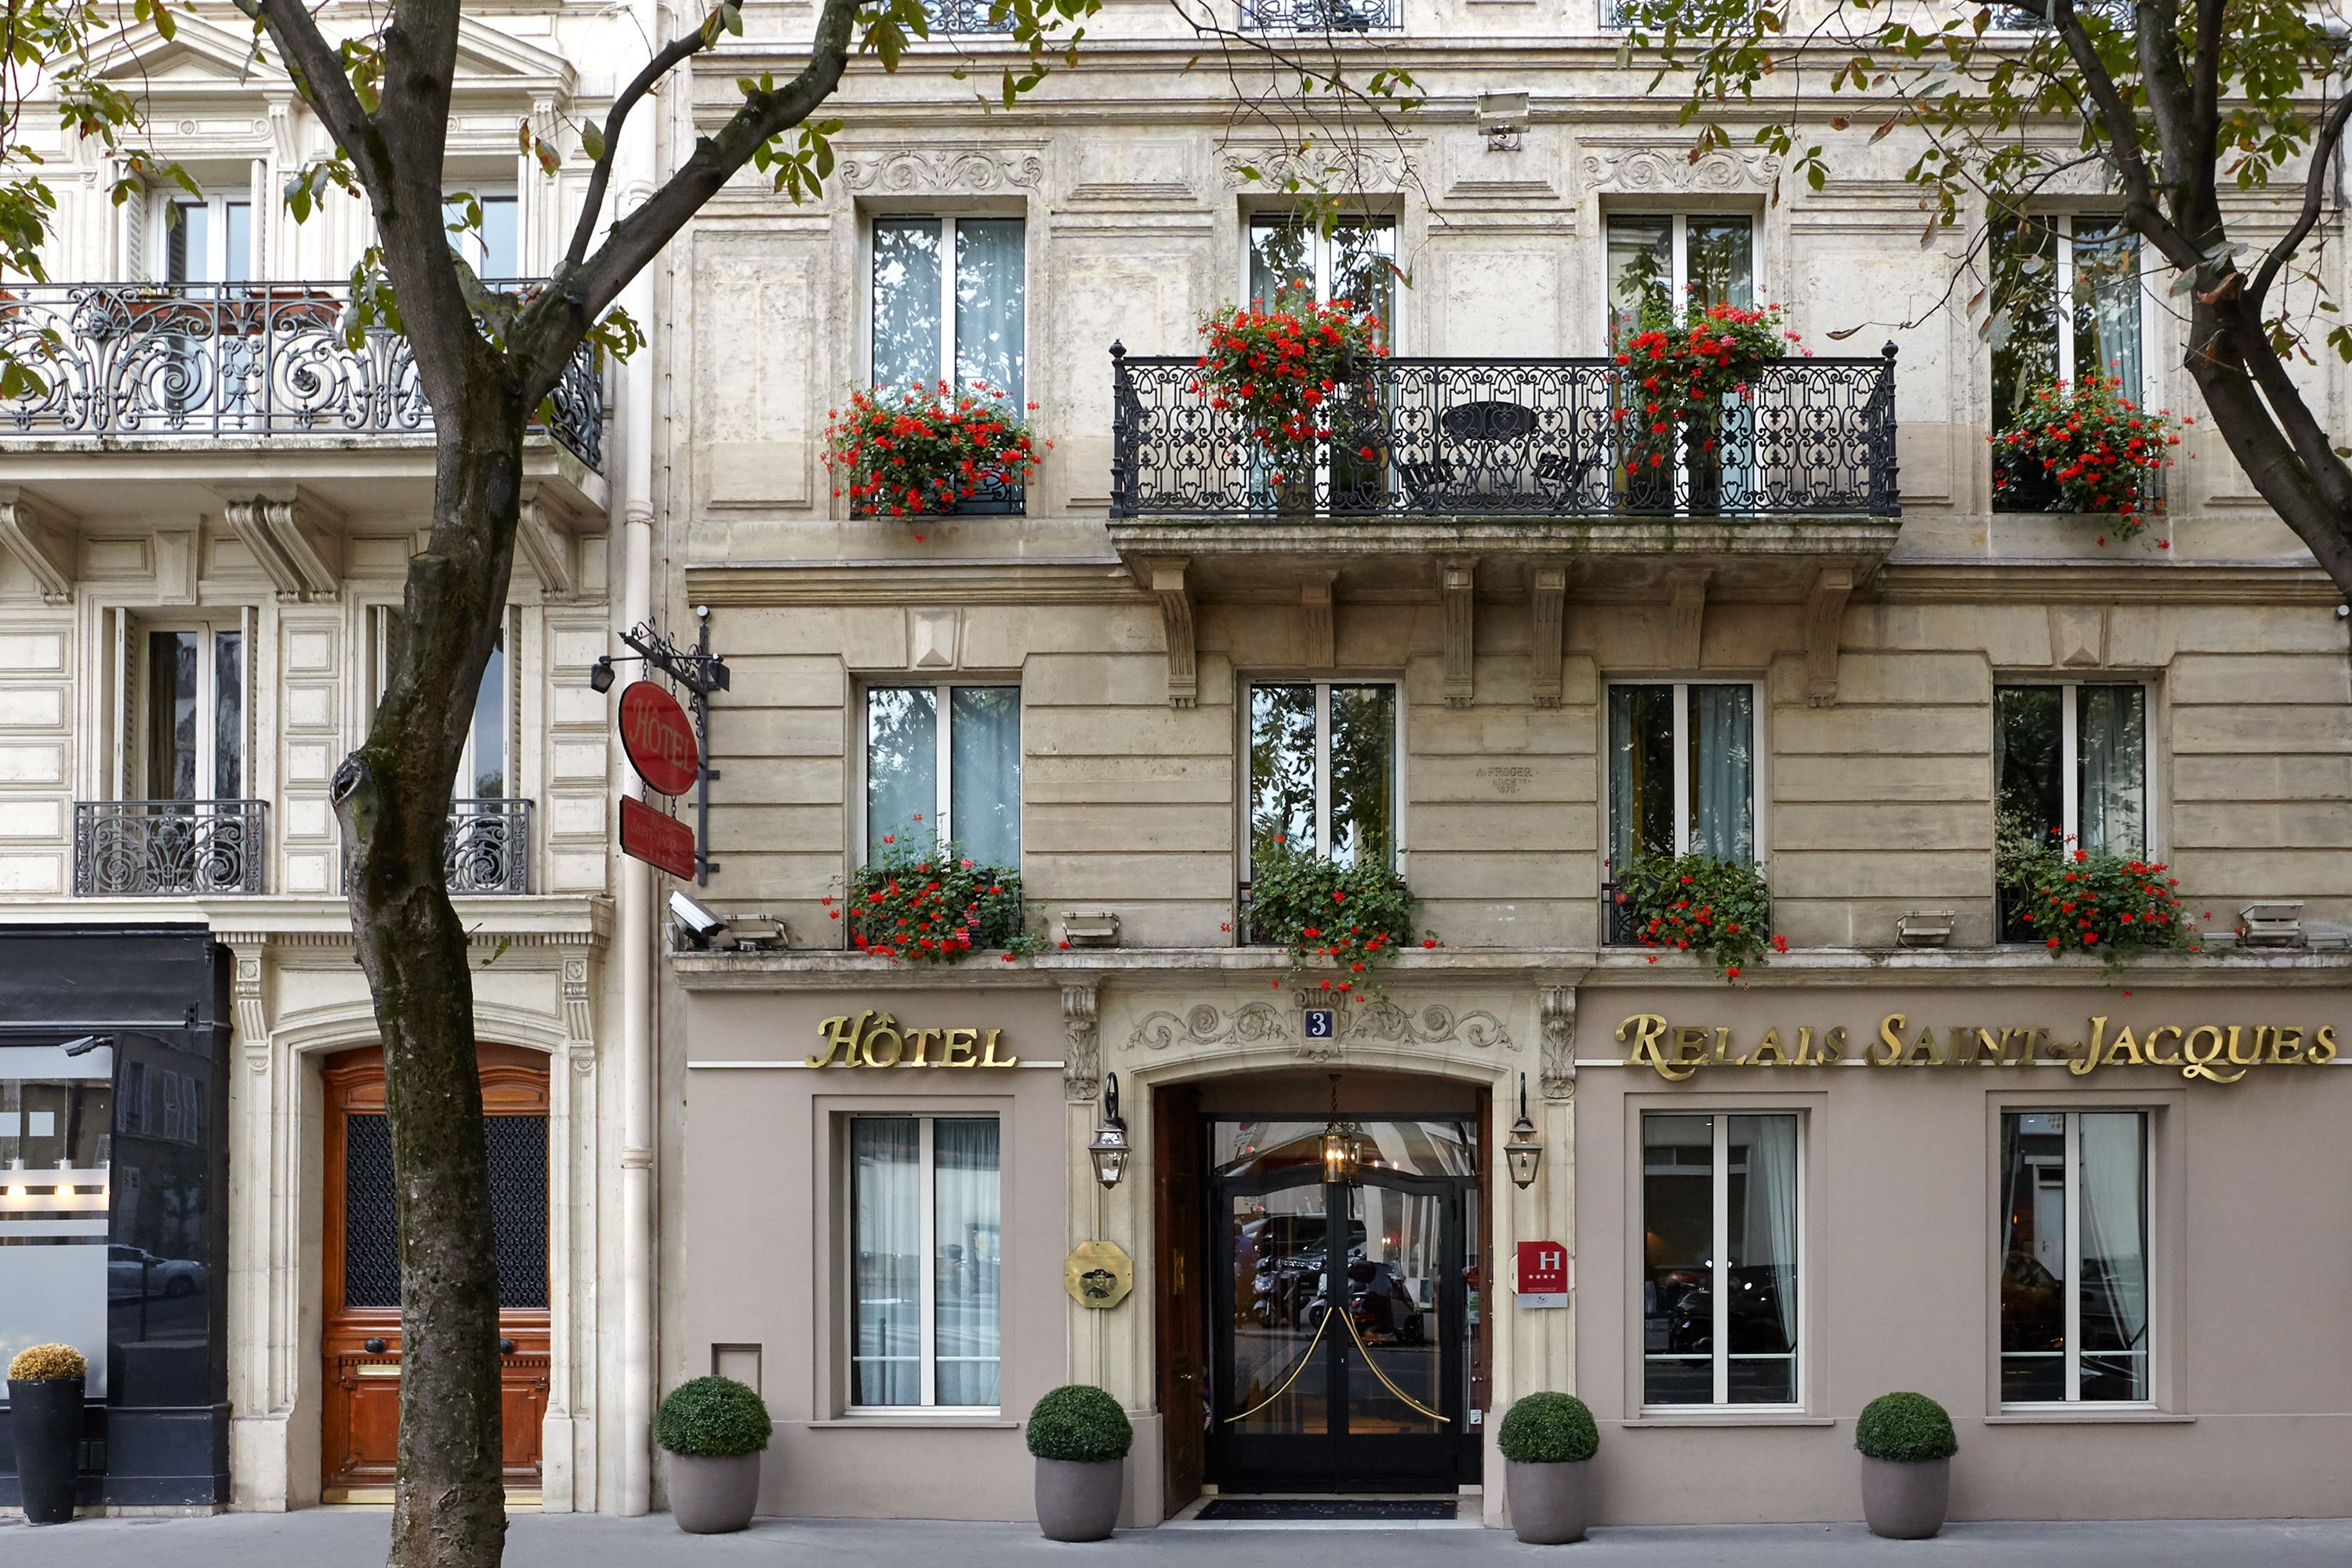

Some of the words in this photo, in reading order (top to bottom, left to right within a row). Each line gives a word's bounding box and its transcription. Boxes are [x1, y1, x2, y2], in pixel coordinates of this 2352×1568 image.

[628, 697, 694, 775] HÔTEL
[805, 1009, 1017, 1069] HÔTEL
[1312, 1012, 1327, 1036] 3
[1615, 1014, 1847, 1081] RELAIS
[1538, 1250, 1562, 1270] H
